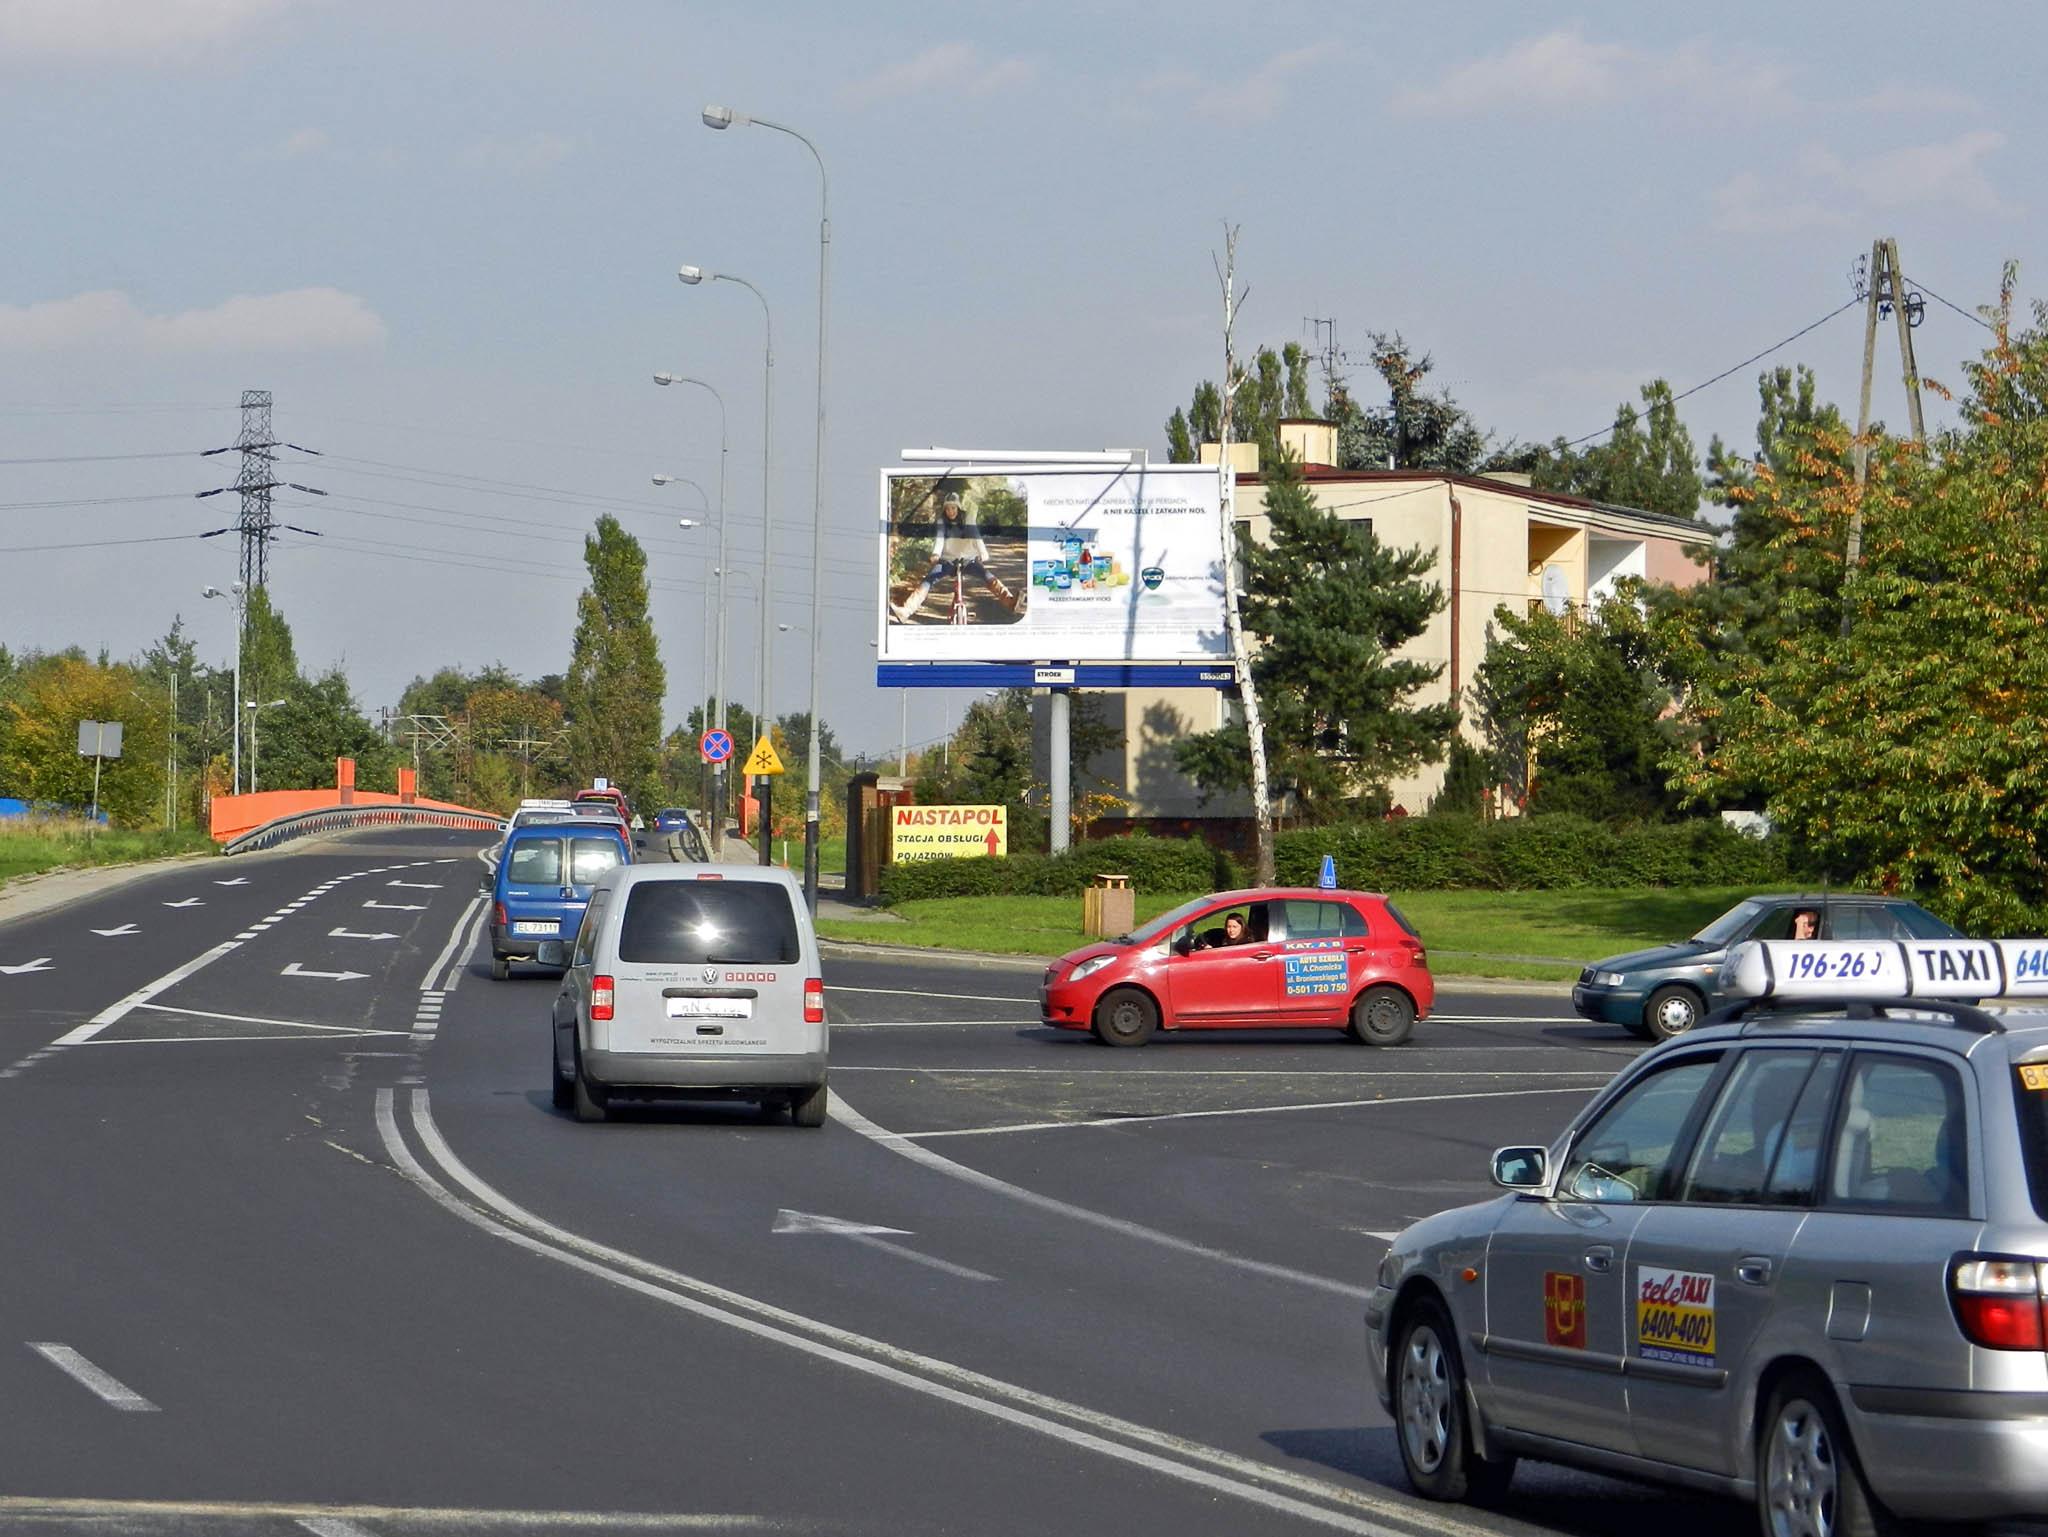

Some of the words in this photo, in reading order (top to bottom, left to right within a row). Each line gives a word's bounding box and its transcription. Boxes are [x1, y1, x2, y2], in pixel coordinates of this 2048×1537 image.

[897, 809, 1003, 825] NASTAPOL
[897, 834, 934, 843] STACJA
[938, 834, 983, 843] OBSŁUGI
[1286, 941, 1314, 950] KAT.
[1918, 949, 1991, 981] TAXI
[1287, 984, 1311, 994] 0-501
[1313, 983, 1329, 993] 720
[1331, 982, 1347, 992] 750
